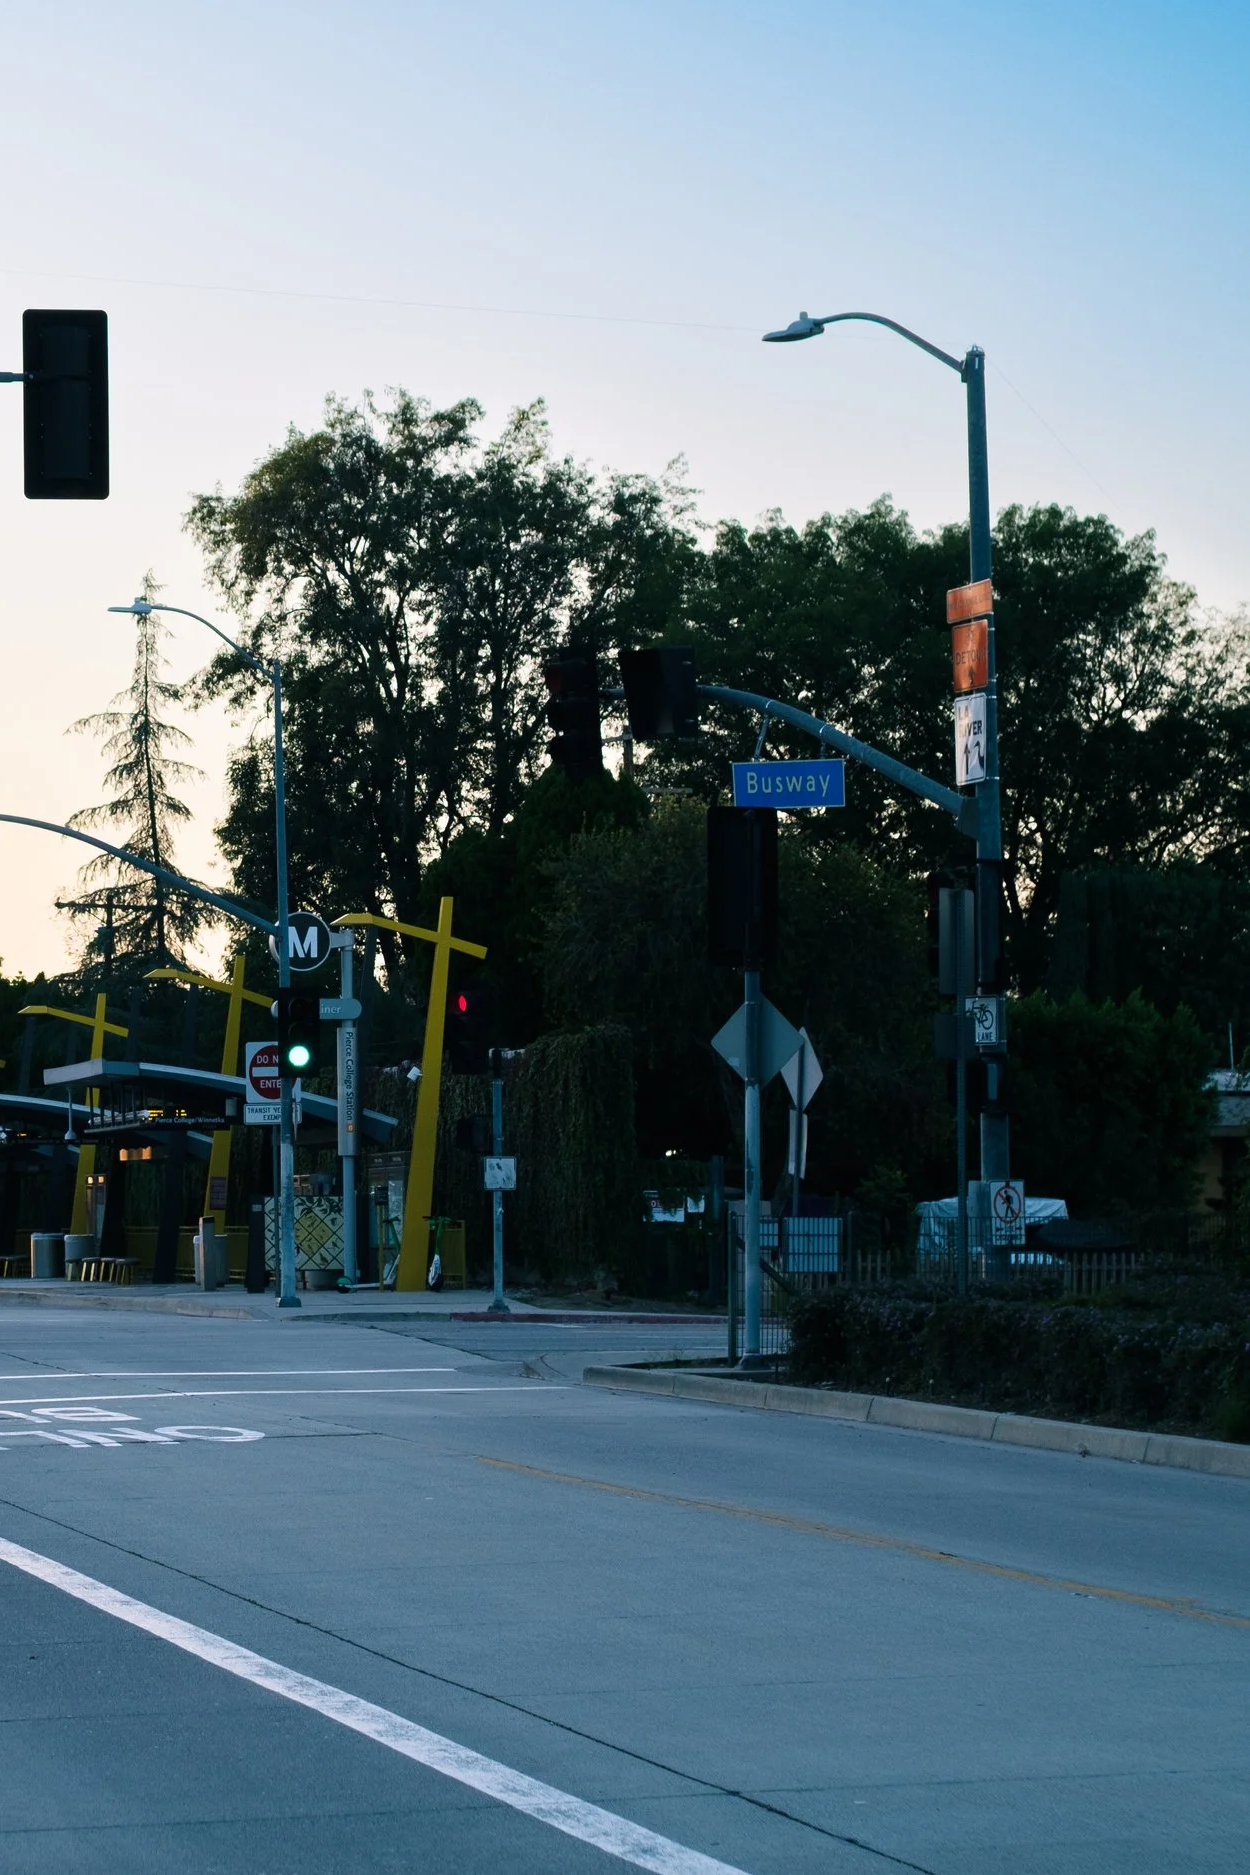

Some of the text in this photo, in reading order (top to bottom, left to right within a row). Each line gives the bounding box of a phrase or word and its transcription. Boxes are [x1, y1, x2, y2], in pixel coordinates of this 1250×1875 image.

[746, 771, 831, 798] Busway
[288, 926, 318, 958] M
[320, 1003, 341, 1014] iner
[345, 1031, 354, 1057] Pierce
[256, 1055, 269, 1064] DO
[260, 1079, 282, 1089] ENTE
[343, 1060, 354, 1090] College
[345, 1091, 354, 1121] Station
